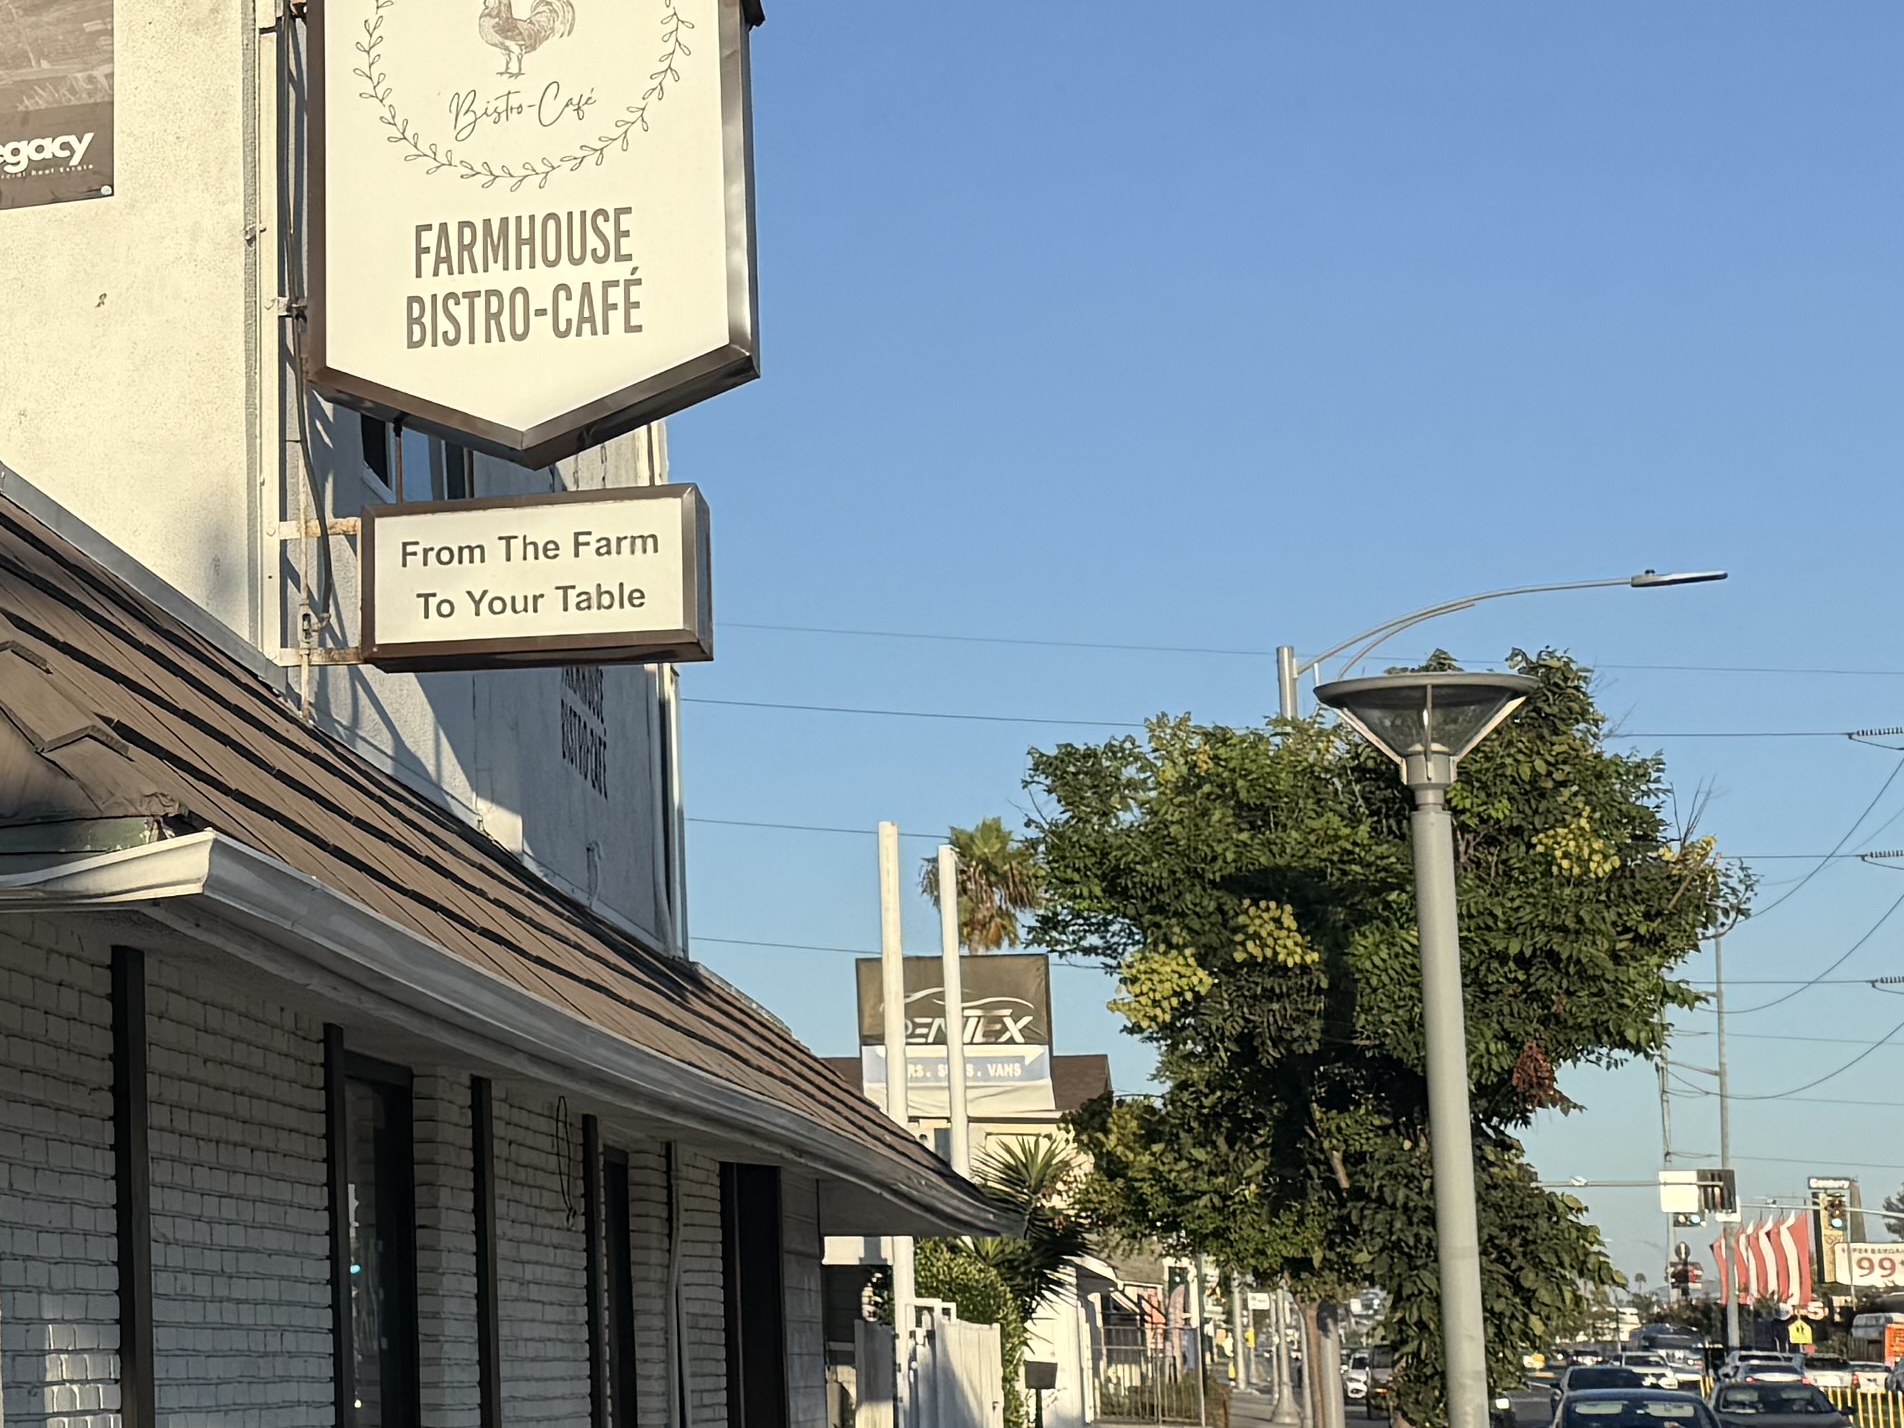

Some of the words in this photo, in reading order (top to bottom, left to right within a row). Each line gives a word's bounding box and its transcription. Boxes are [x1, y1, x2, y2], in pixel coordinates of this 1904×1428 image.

[414, 206, 634, 279] FARMHOUSE
[405, 265, 644, 350] BISTRO-CAFÉ
[401, 540, 485, 568] From
[498, 534, 560, 562] The
[573, 530, 659, 558] Farm
[416, 592, 456, 620] To
[465, 589, 545, 617] Your
[555, 582, 646, 612] Table
[905, 1009, 1034, 1043] ENTEX
[987, 1062, 1022, 1078] VANS
